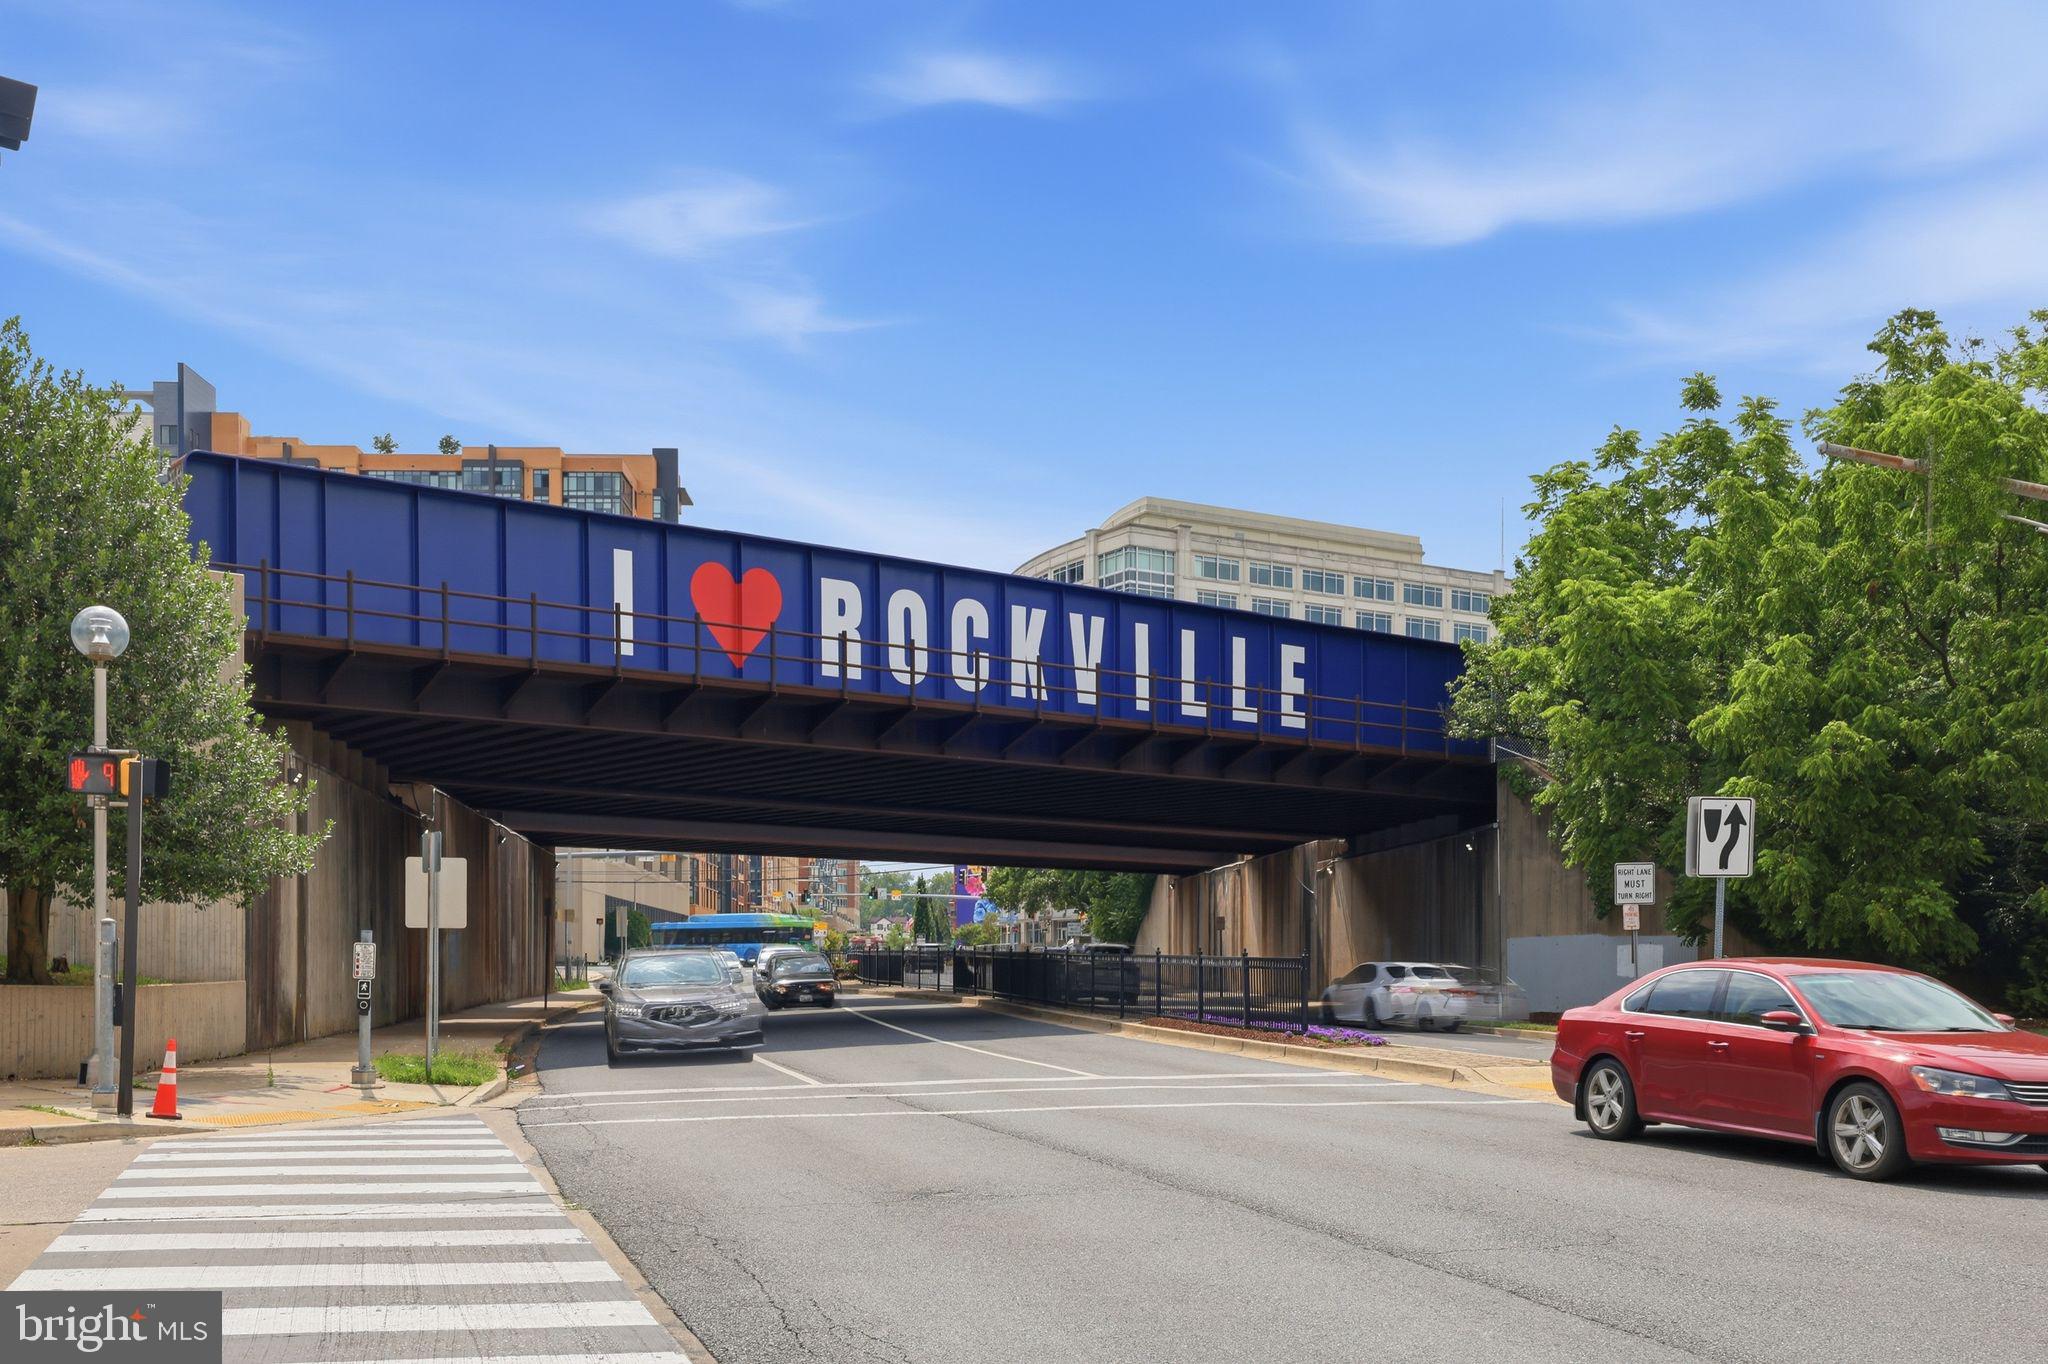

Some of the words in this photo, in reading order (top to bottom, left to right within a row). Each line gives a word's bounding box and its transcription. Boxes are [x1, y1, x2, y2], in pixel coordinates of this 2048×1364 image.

[613, 548, 634, 656] I
[820, 577, 1306, 729] ROCKVILLE
[103, 762, 115, 788] 9
[1617, 868, 1634, 876] RIGHT
[1636, 868, 1652, 876] LANE
[1624, 880, 1646, 888] MUST
[1617, 892, 1633, 900] TURN
[1635, 892, 1652, 900] RIGHT
